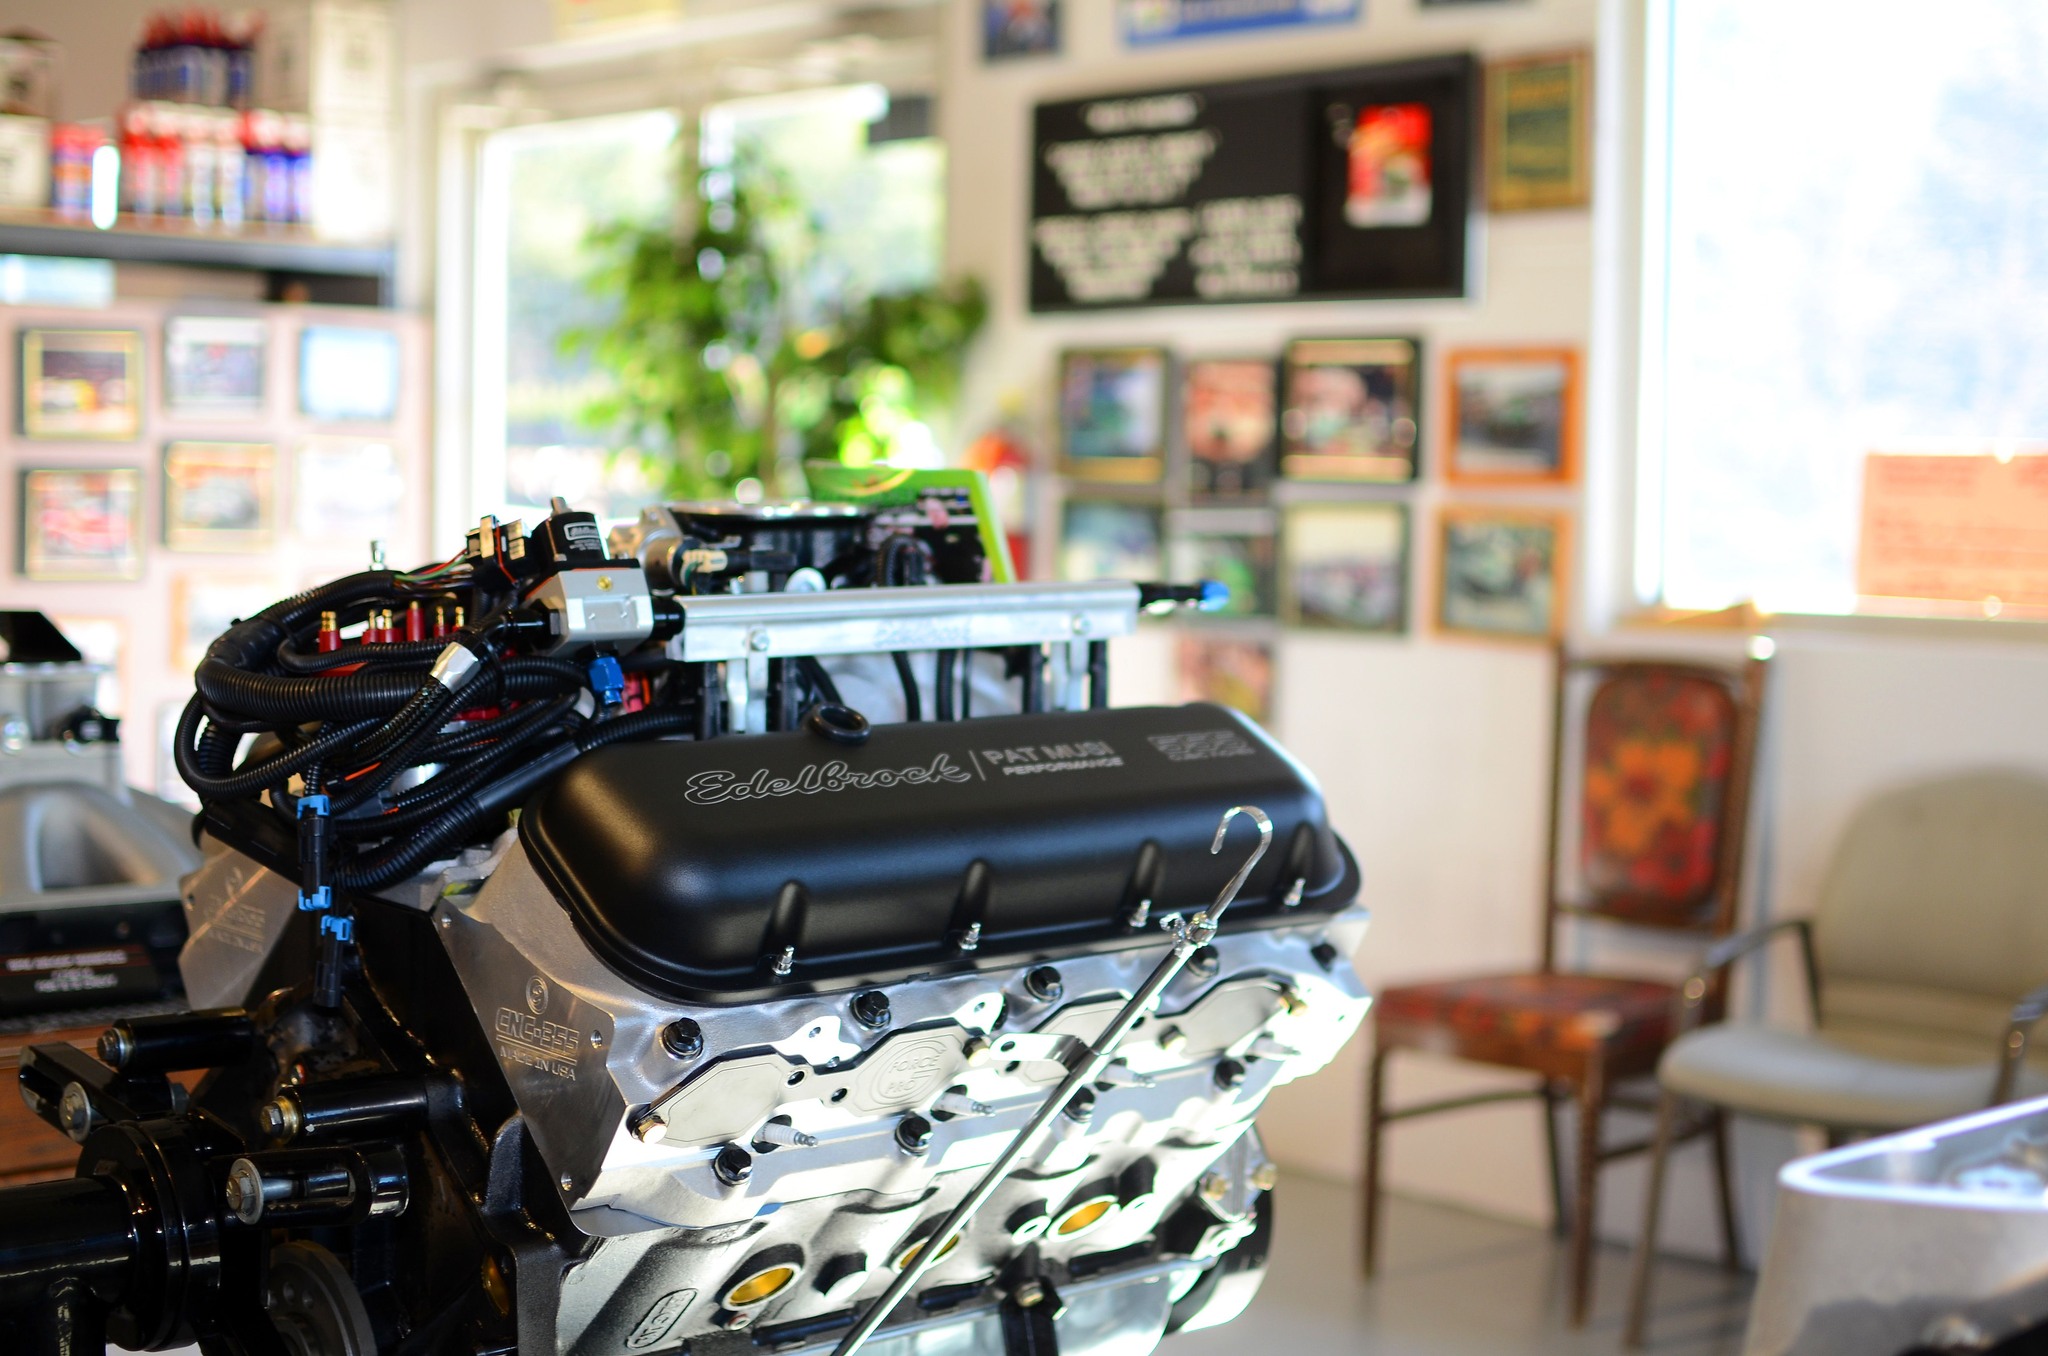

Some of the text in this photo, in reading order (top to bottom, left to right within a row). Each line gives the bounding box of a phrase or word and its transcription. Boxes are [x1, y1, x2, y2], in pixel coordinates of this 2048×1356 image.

[982, 741, 1114, 765] PAT MUSI
[1002, 757, 1123, 776] PERFORMANCE
[684, 753, 971, 805] Edelbrock
[500, 1045, 576, 1082] MADE IN USA
